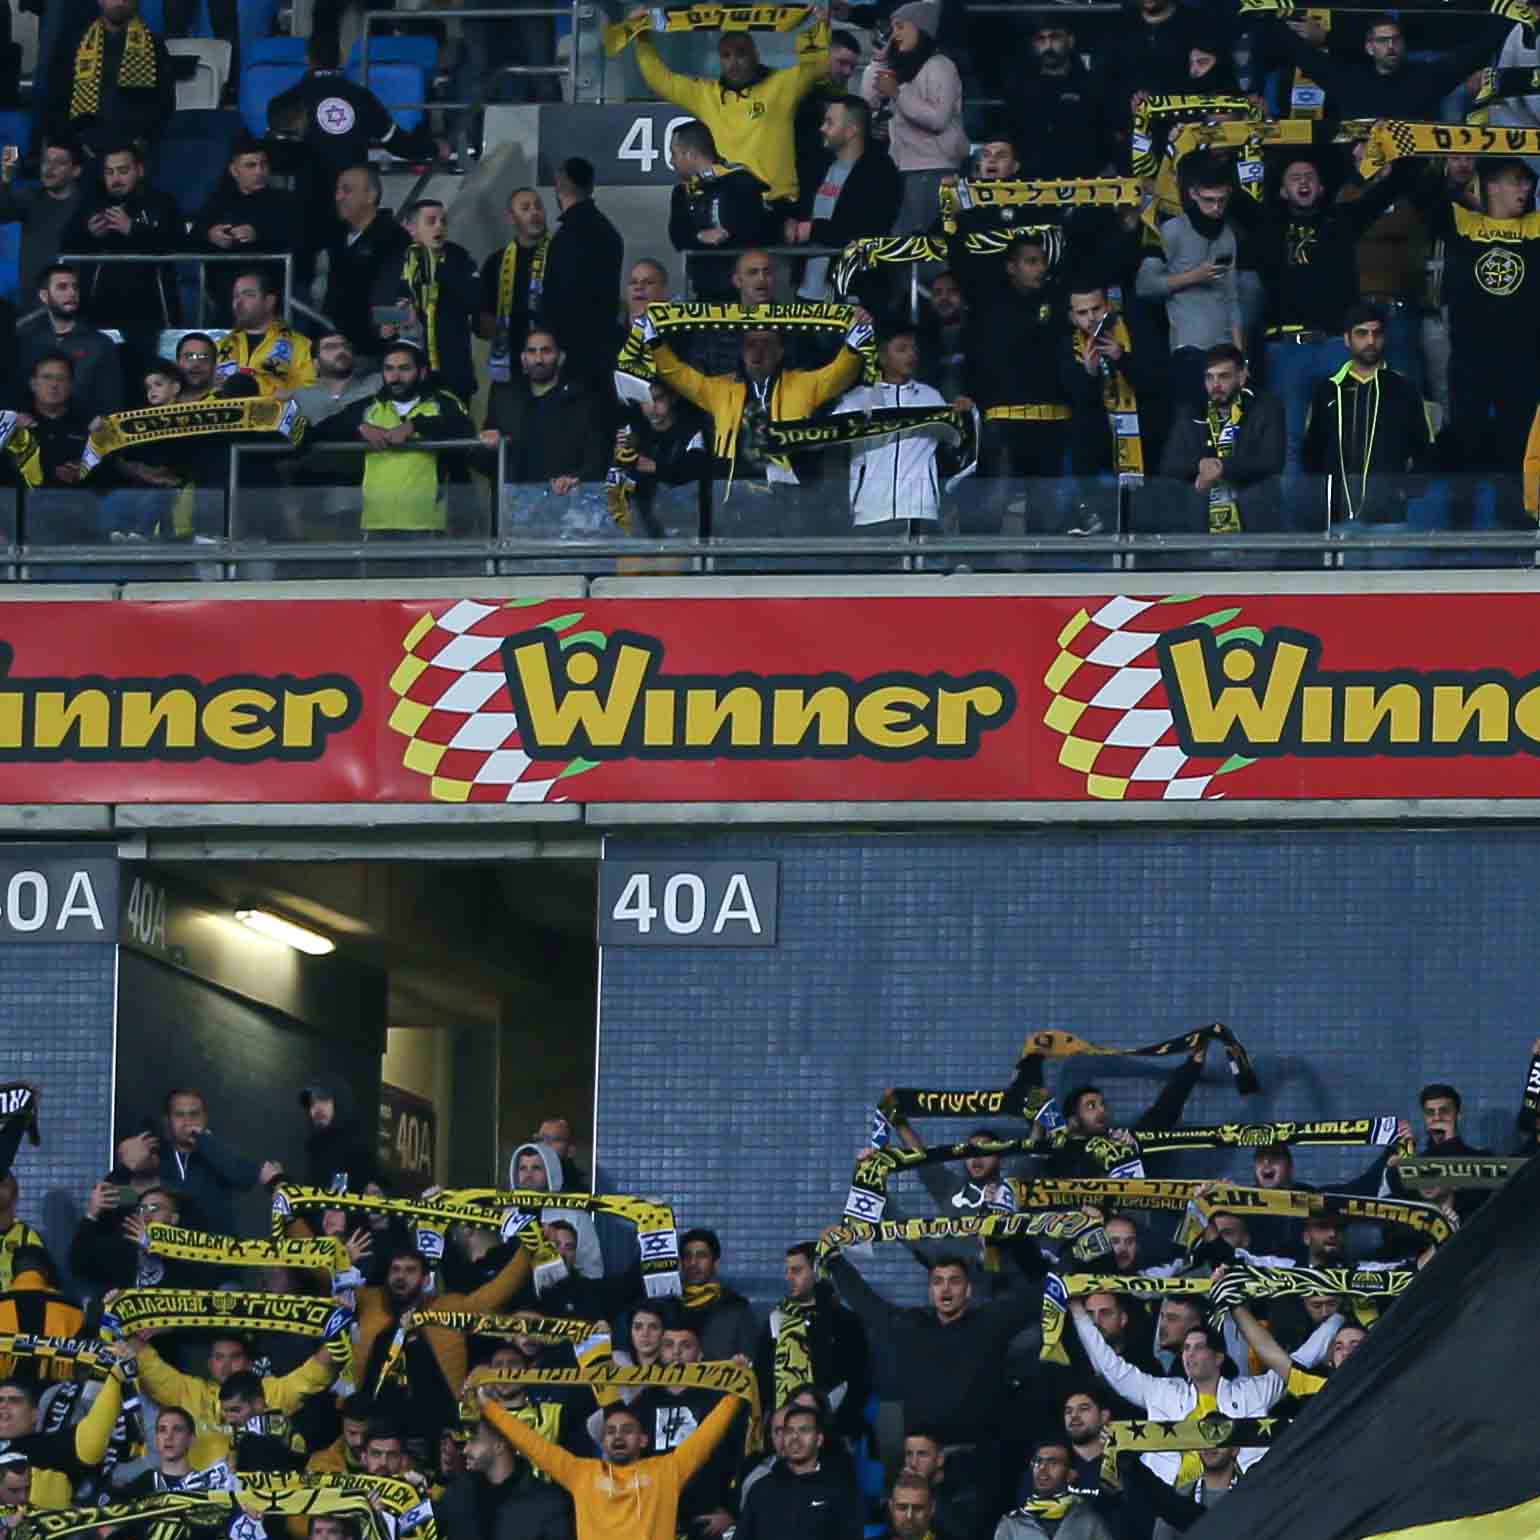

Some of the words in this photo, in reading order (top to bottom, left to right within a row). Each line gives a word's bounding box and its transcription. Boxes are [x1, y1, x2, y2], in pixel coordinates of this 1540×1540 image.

[977, 185, 1142, 205] ירושלים
[0, 686, 349, 749] inner
[516, 641, 1003, 748] Winner
[0, 871, 105, 931] 0A
[613, 873, 762, 934] 40A
